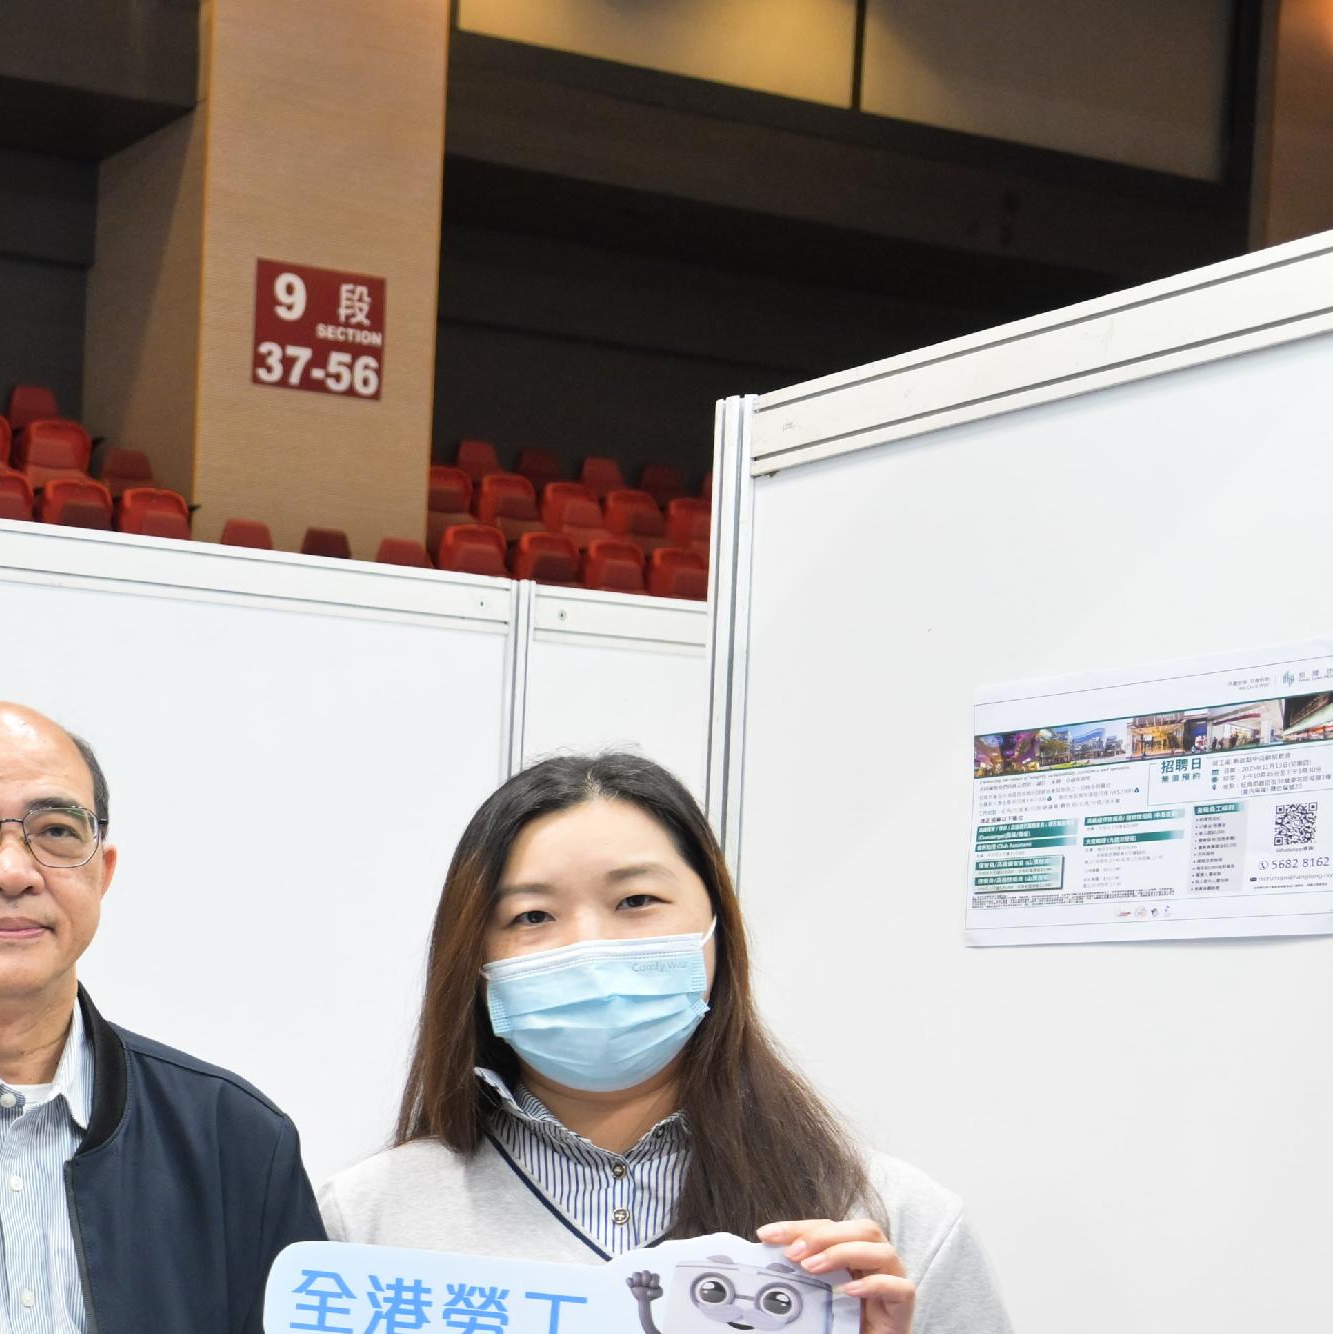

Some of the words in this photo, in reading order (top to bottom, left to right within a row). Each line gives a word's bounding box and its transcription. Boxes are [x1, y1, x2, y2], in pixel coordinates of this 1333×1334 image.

[273, 272, 307, 321] 9
[337, 283, 372, 326] 段
[315, 322, 382, 347] SECTION
[256, 341, 380, 396] 37-56
[1161, 757, 1202, 774] 招聘日
[1272, 859, 1298, 870] 5682
[1303, 856, 1330, 867] 8162
